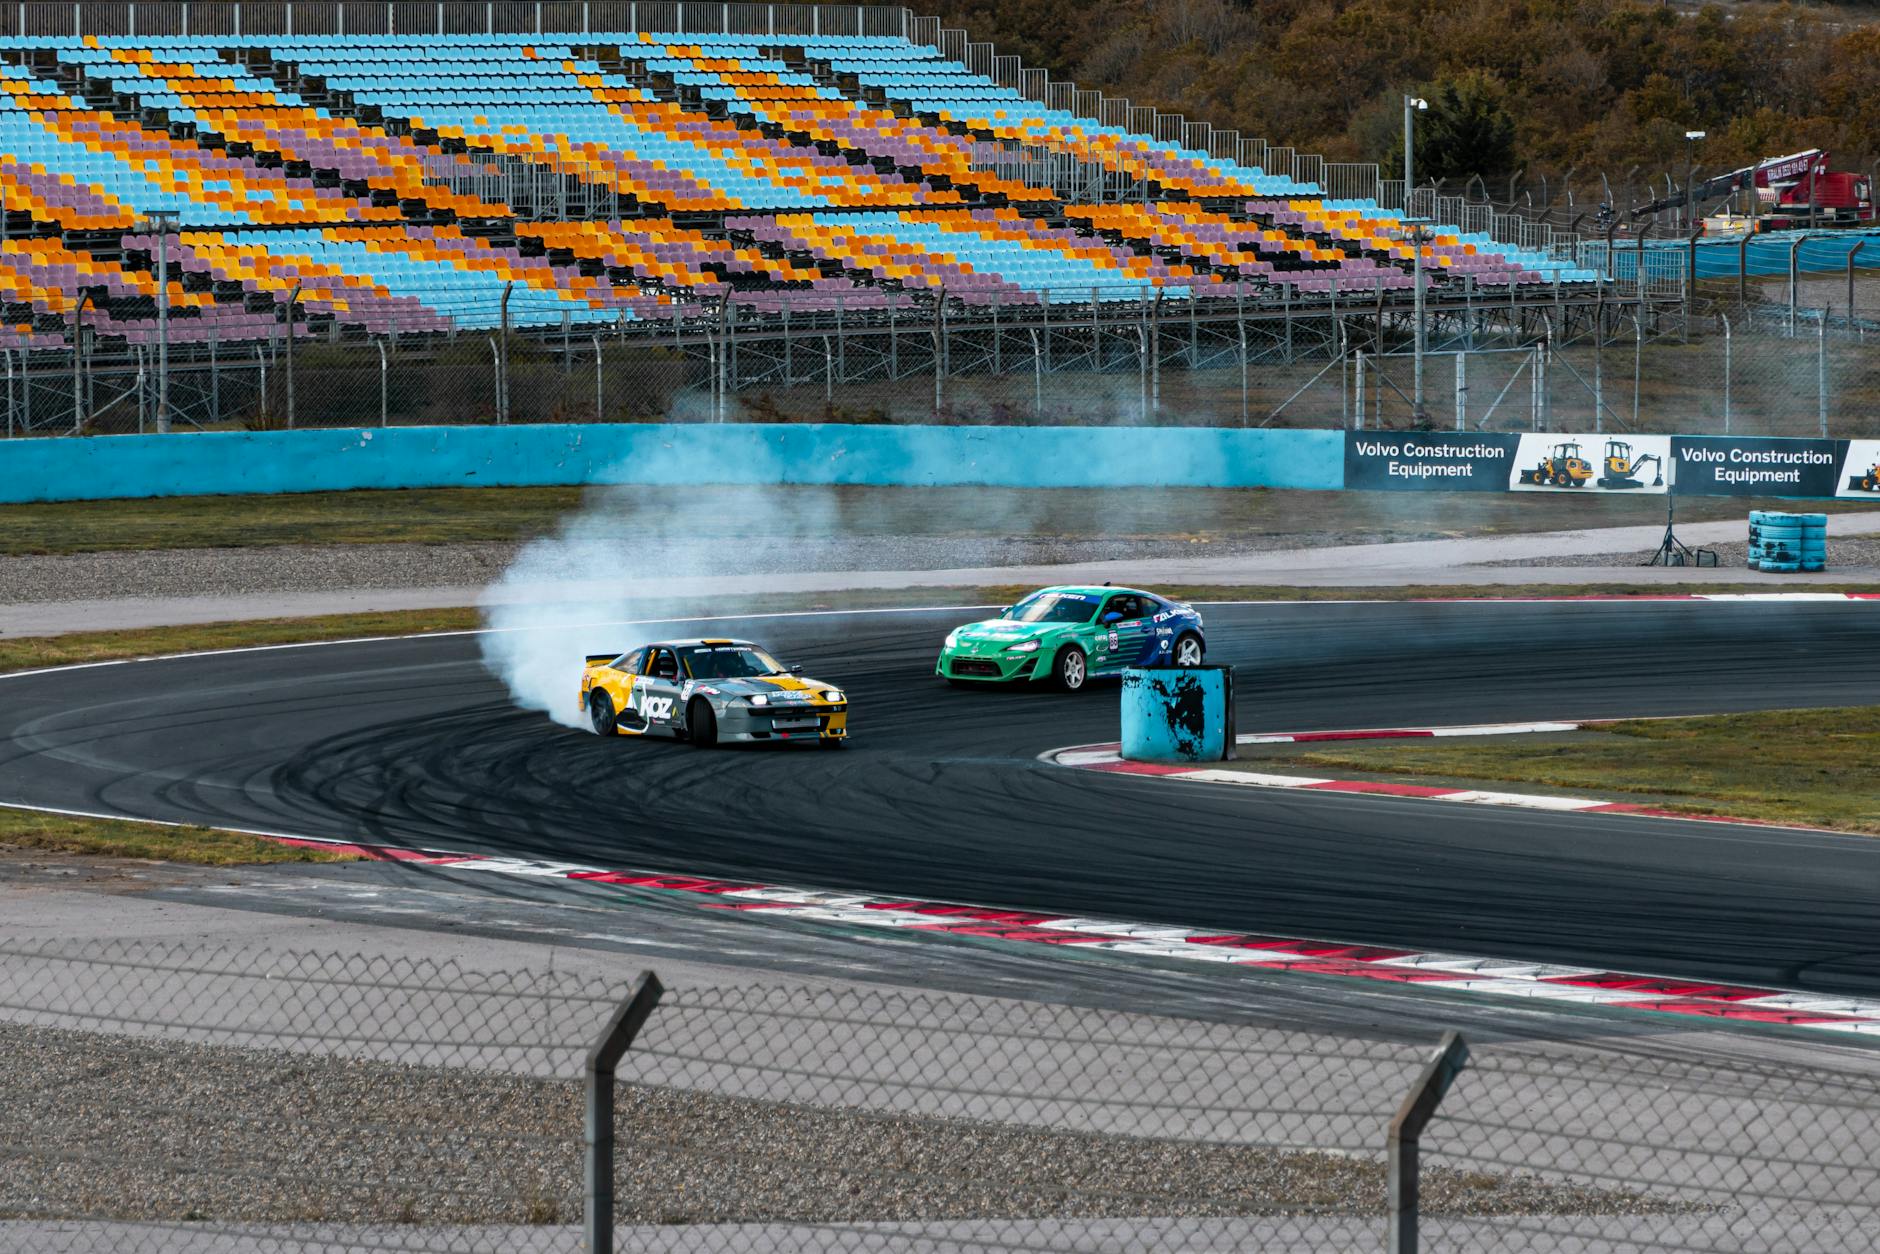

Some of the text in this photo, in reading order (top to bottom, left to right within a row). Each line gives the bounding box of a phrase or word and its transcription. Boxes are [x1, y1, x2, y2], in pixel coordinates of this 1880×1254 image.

[1356, 441, 1505, 458] Volvo Construction
[1681, 447, 1833, 464] Volvo Construction
[1388, 461, 1473, 479] Equipment
[1715, 467, 1800, 484] Equipment
[639, 695, 673, 720] KOZ
